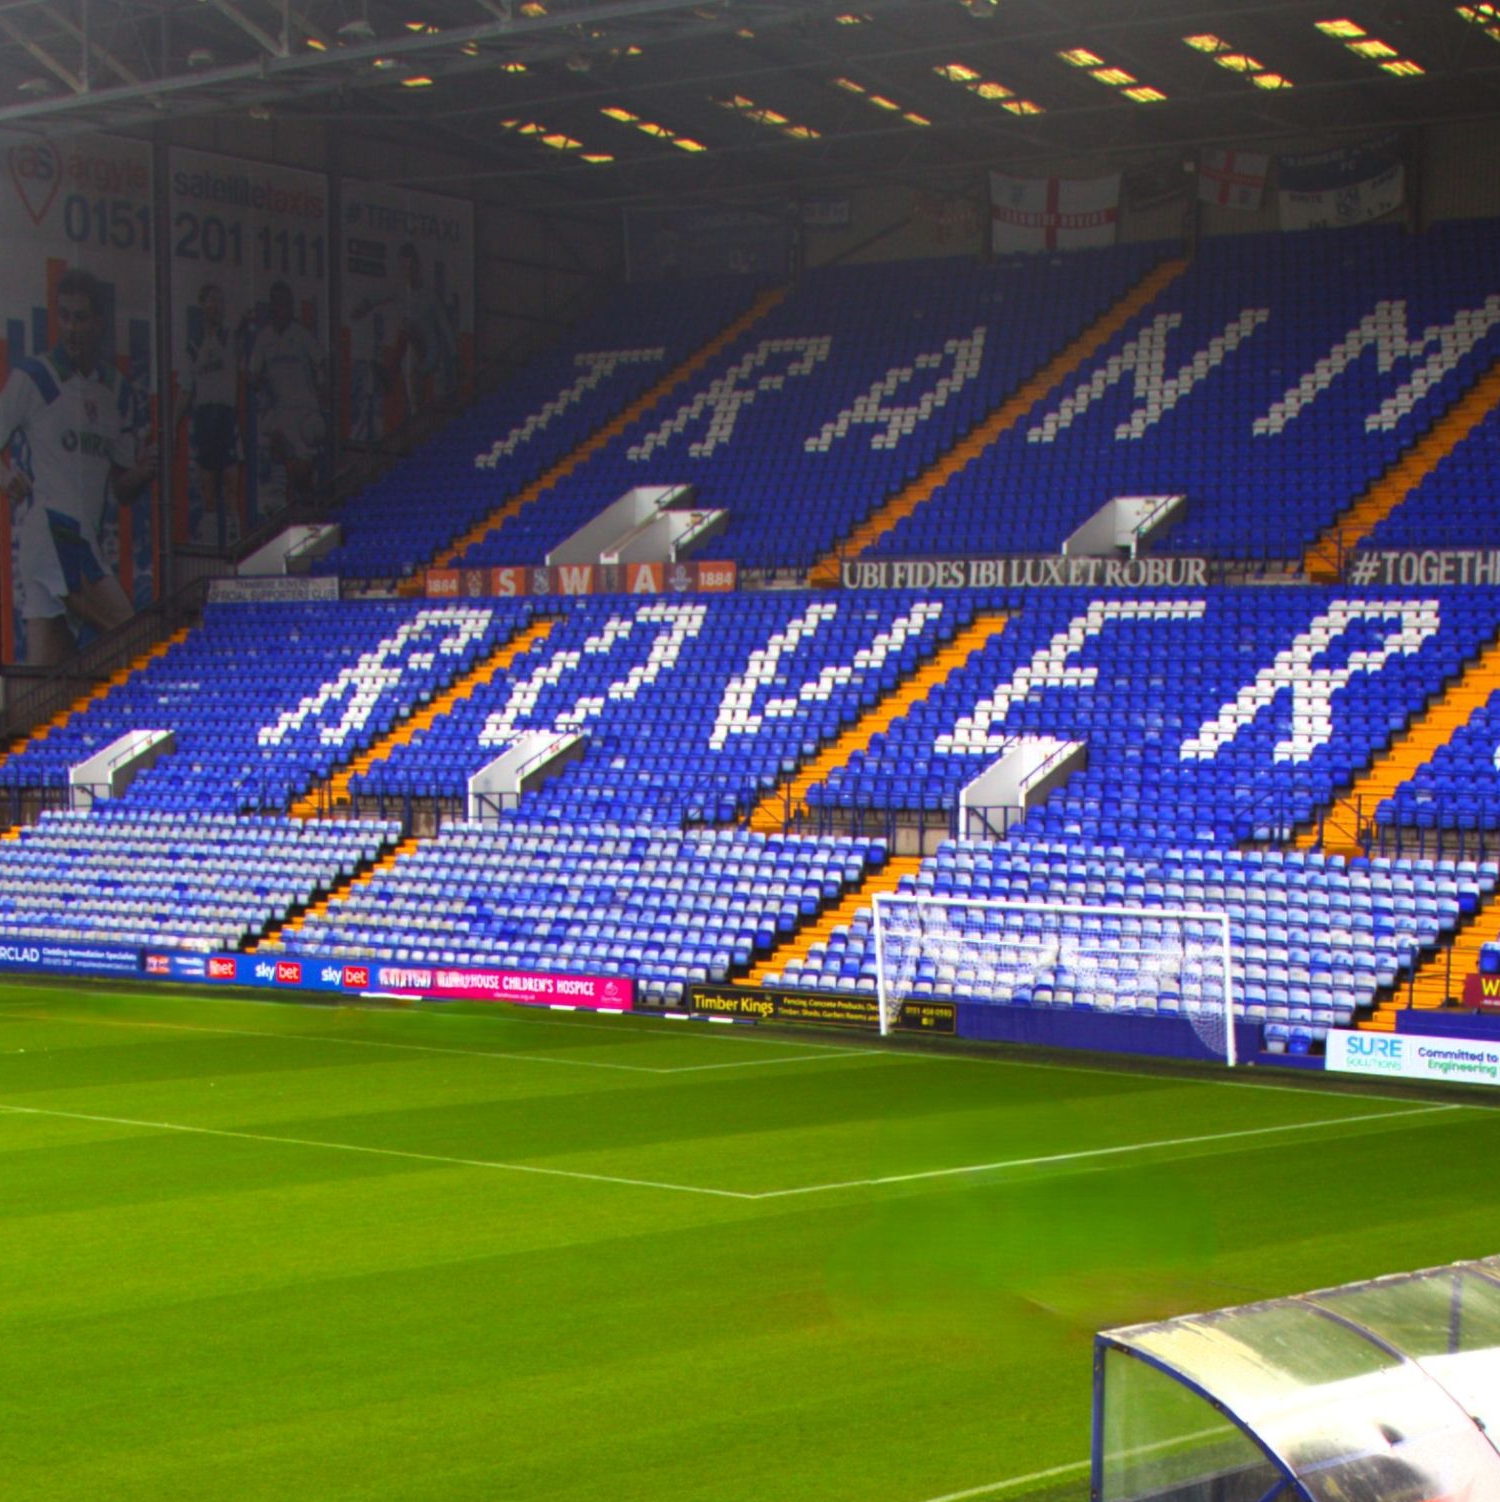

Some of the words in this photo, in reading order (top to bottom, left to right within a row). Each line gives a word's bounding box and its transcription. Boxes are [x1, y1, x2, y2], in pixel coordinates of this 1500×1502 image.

[63, 194, 151, 252] 0151
[173, 211, 241, 267] 201
[256, 224, 325, 278] 1111
[428, 578, 457, 594] 1884
[498, 568, 517, 596] S
[559, 566, 593, 597] W
[632, 565, 658, 594] A
[699, 571, 733, 588] 1884
[841, 562, 887, 588] UBI
[891, 560, 964, 588] FIDES
[968, 560, 1008, 587] IBI
[1010, 559, 1068, 587] LUX
[1069, 559, 1099, 586] ET
[1104, 558, 1207, 586] ROBUR
[255, 962, 275, 980] sky
[279, 963, 299, 980] bet
[321, 968, 342, 986] sky
[346, 968, 367, 985] bet
[502, 976, 554, 993] CHILDREN'S
[556, 980, 595, 996] HOSPICE
[693, 994, 738, 1011] Timber
[740, 998, 775, 1018] Kings
[1346, 1037, 1403, 1058] SURE
[1418, 1047, 1485, 1062] Committed
[1486, 1051, 1499, 1063] to
[1427, 1060, 1498, 1078] Engineering
